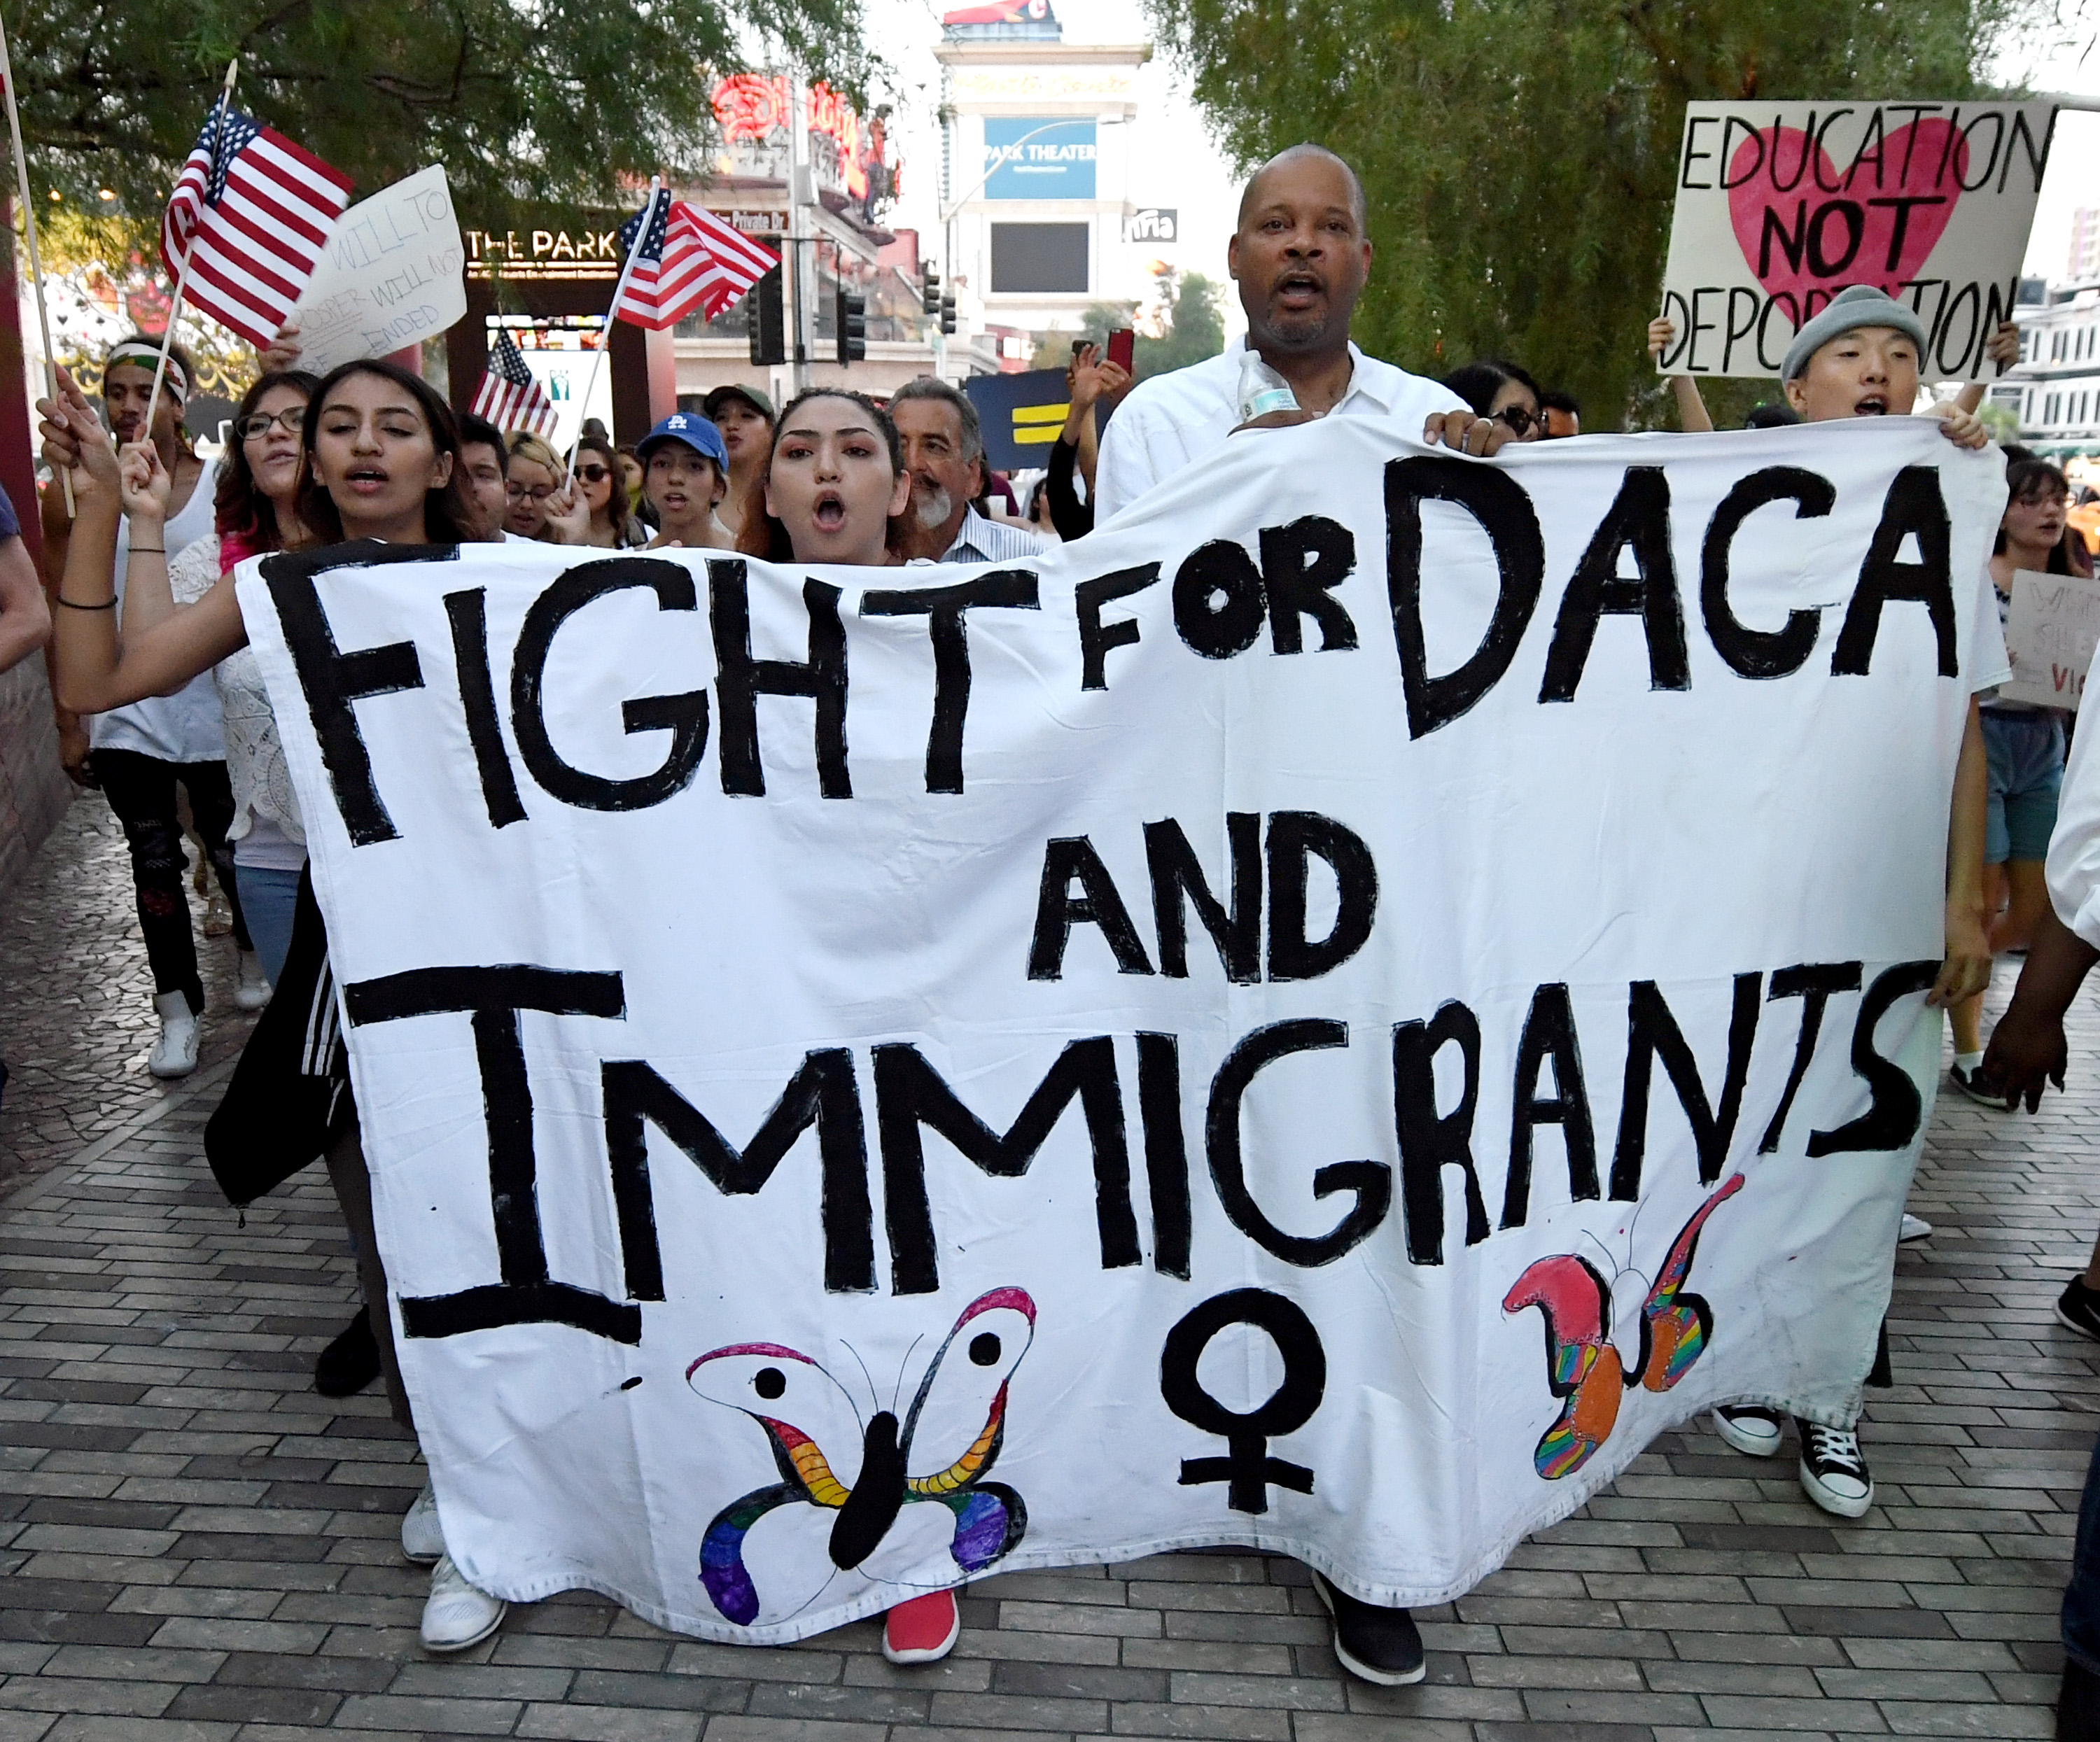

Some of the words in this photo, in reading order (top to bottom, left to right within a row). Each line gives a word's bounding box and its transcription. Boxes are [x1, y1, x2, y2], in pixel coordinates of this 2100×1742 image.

[983, 144, 1023, 160] PARK
[1027, 144, 1097, 160] THEATER
[1681, 103, 2060, 195] EDUCATION
[330, 203, 419, 270] WILL
[403, 188, 449, 233] TO
[466, 230, 524, 259] THE
[531, 230, 617, 259] PARK
[732, 210, 769, 230] Private
[771, 211, 784, 230] Dr
[1758, 195, 1947, 279] NOT
[370, 263, 434, 308] WILL
[427, 246, 462, 277] NOT
[361, 304, 440, 354] ENDED
[1660, 275, 2019, 379] DEPOTION
[258, 542, 1039, 847] FIGHT
[1077, 515, 1357, 691] FOR
[1382, 458, 1959, 740] DACA
[1026, 810, 1378, 984] AND
[344, 958, 1935, 1343] IMMIGRANTS
